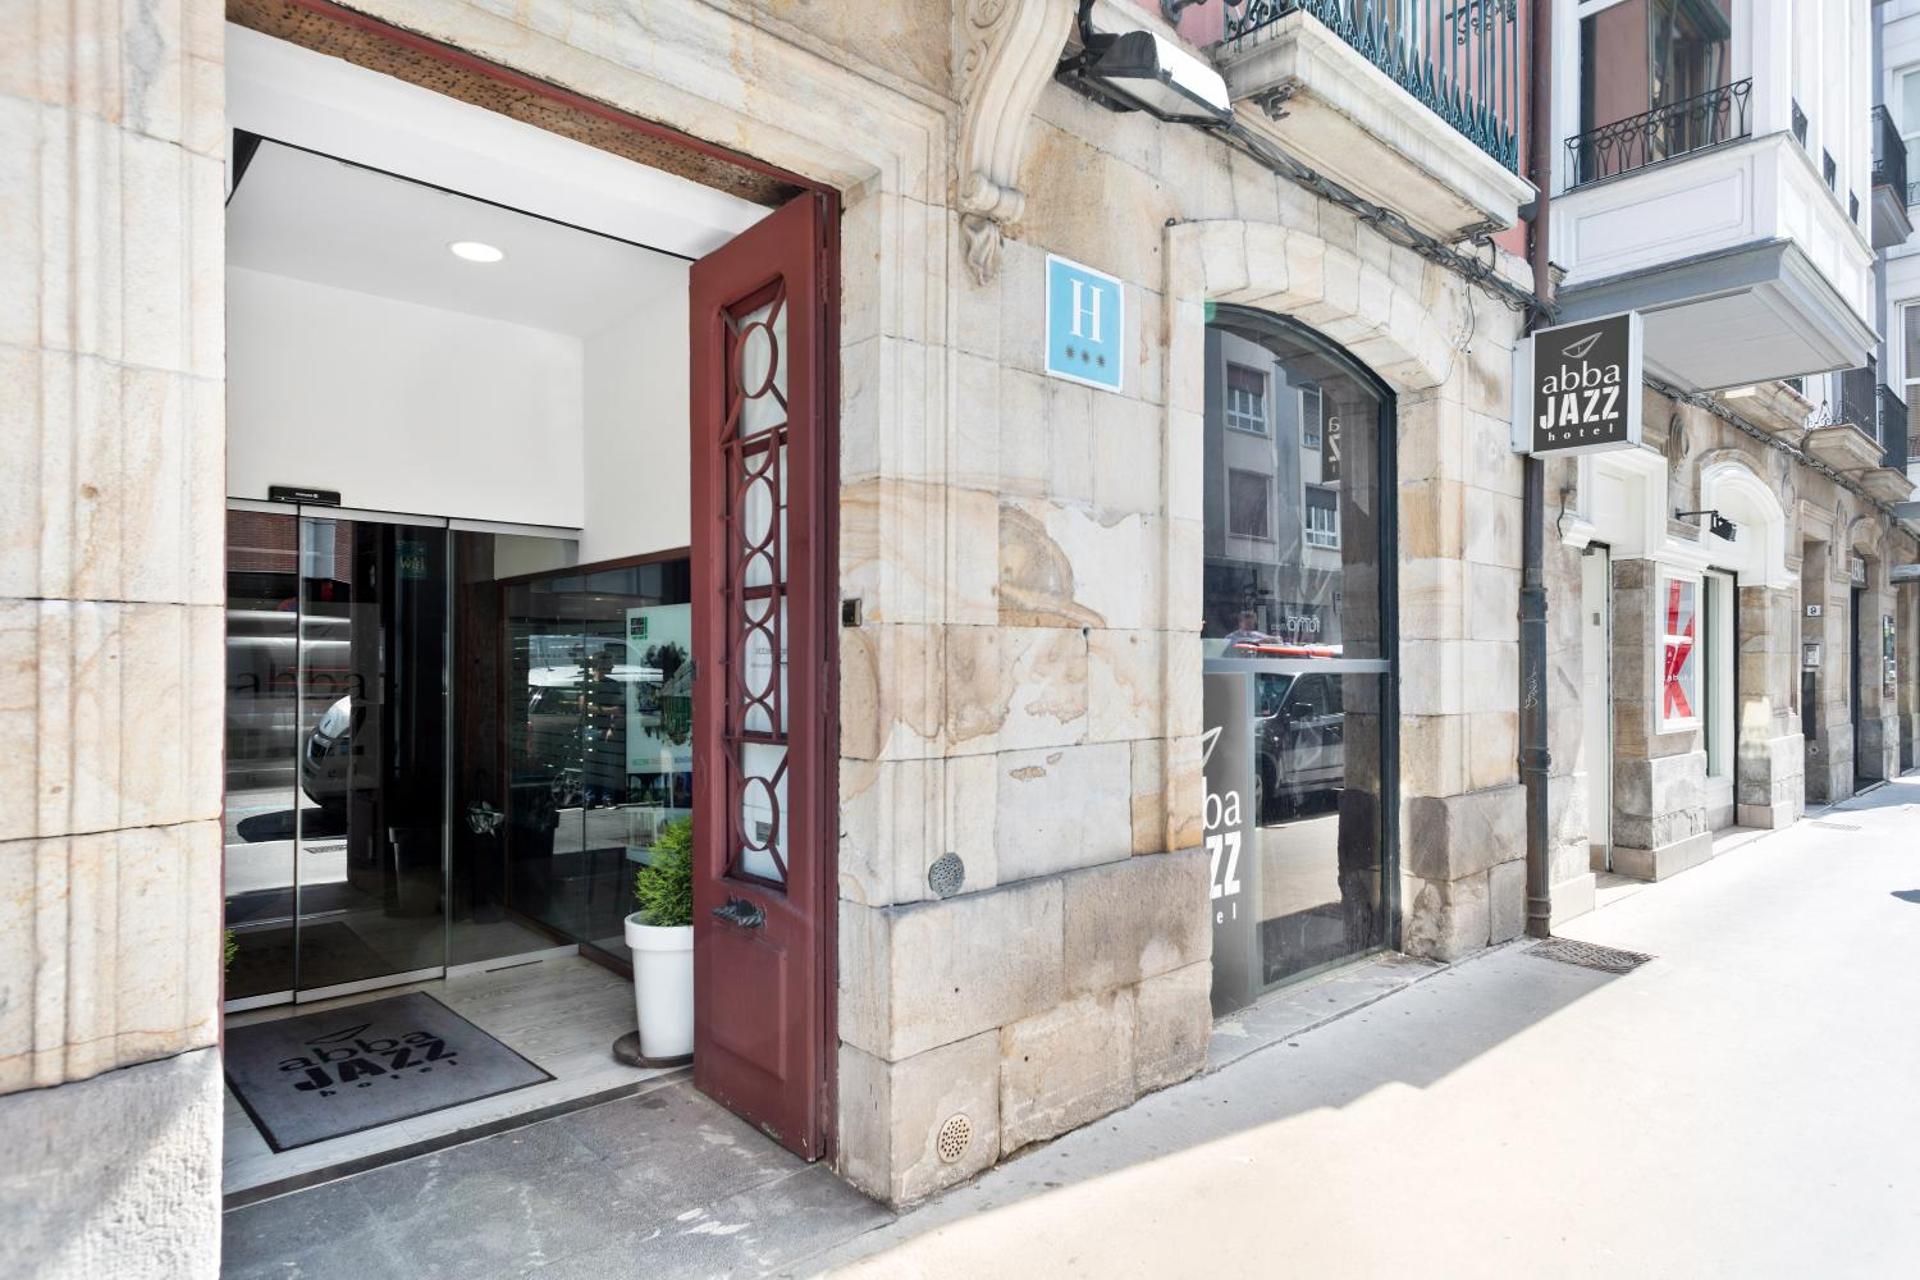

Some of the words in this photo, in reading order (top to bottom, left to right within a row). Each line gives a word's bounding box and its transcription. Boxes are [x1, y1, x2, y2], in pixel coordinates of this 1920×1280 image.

[1069, 278, 1104, 344] H
[1541, 360, 1621, 395] abba
[1539, 385, 1620, 430] JAZZ
[1548, 422, 1614, 441] hotel
[278, 1030, 440, 1072] abba
[294, 1038, 457, 1091] JAZZ
